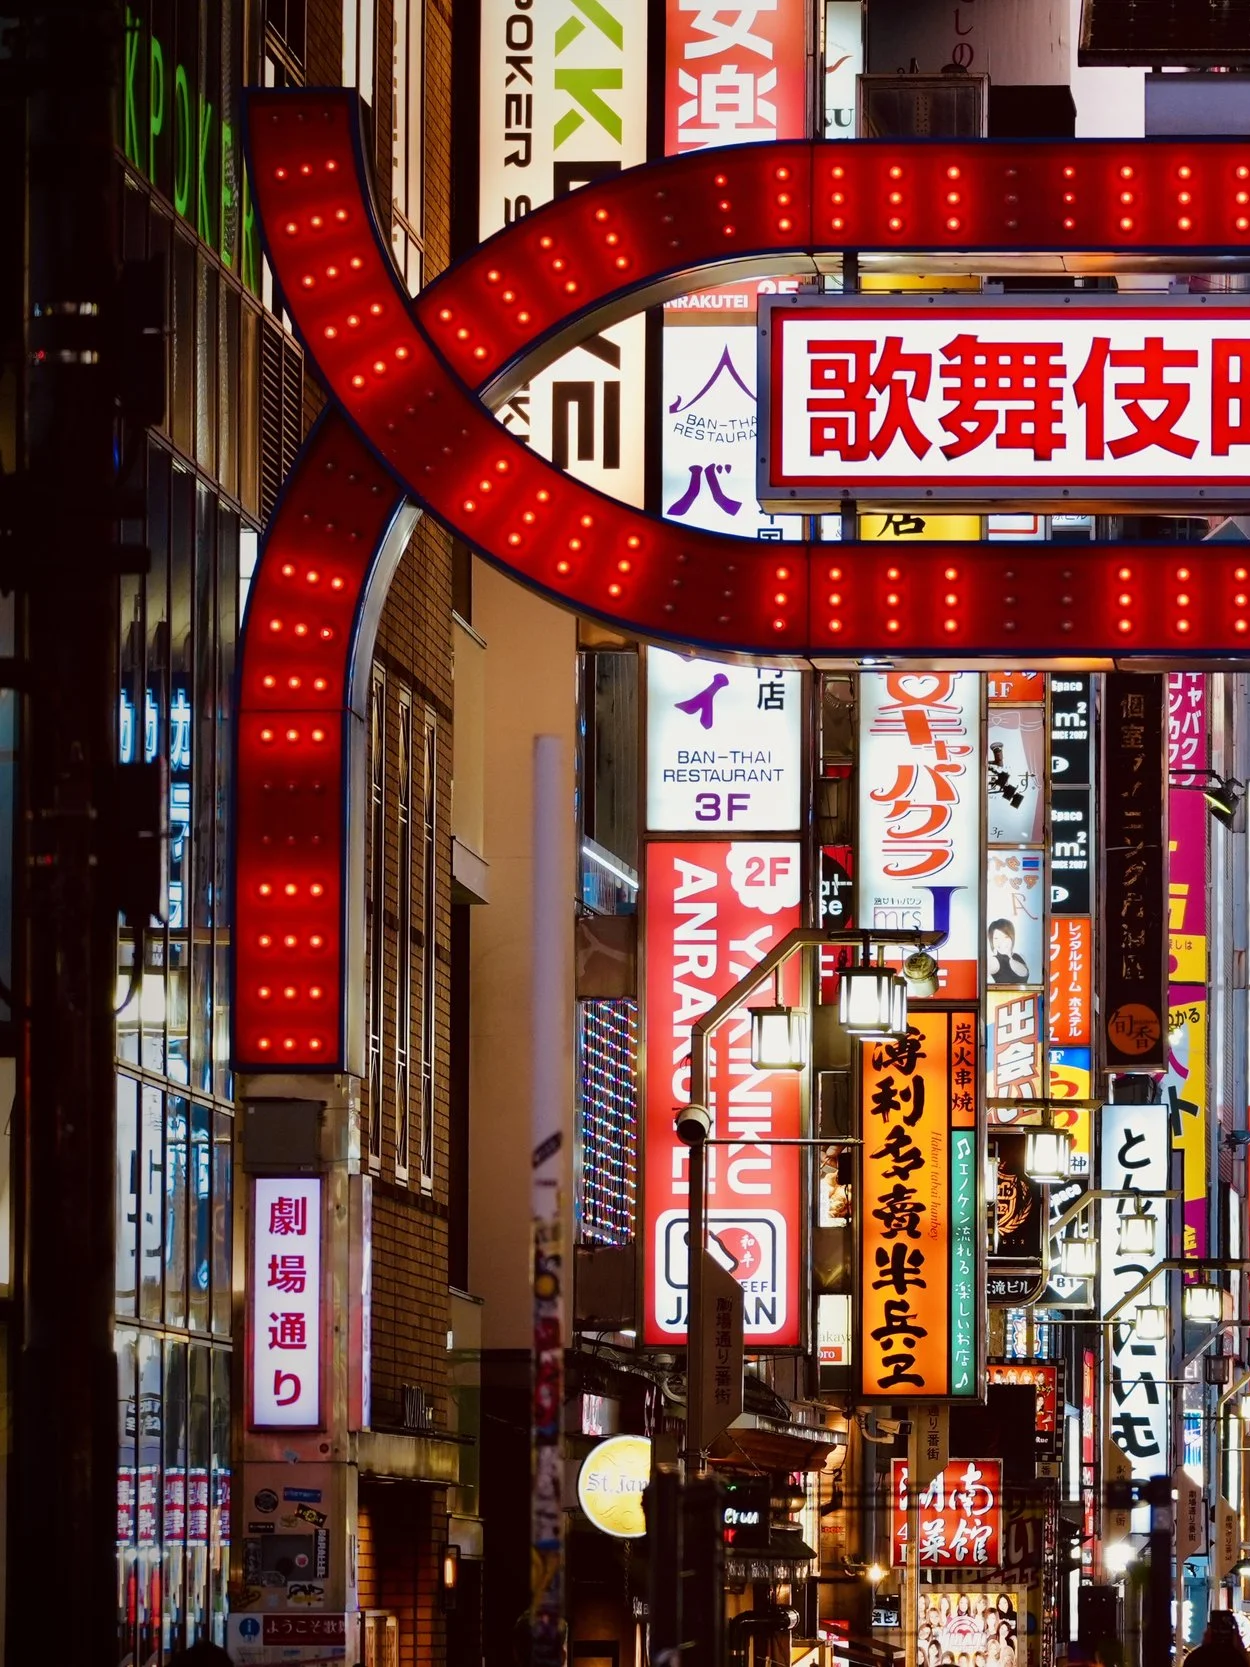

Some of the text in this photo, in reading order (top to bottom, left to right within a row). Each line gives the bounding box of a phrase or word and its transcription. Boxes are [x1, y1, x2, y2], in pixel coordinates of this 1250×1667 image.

[676, 0, 778, 153] 安楽
[674, 673, 730, 730] イ
[663, 769, 785, 783] RESTAURANT
[677, 751, 772, 764] BAN-THAI
[695, 793, 751, 822] 3F
[744, 856, 791, 887] 2F
[1068, 922, 1083, 992] レンタルルーム
[1068, 997, 1083, 1037] ホステル
[951, 1023, 974, 1113] 炭火串焼
[739, 1235, 756, 1268] 和牛
[268, 1196, 307, 1406] 劇場通り
[955, 1282, 972, 1368] 楽しいお店
